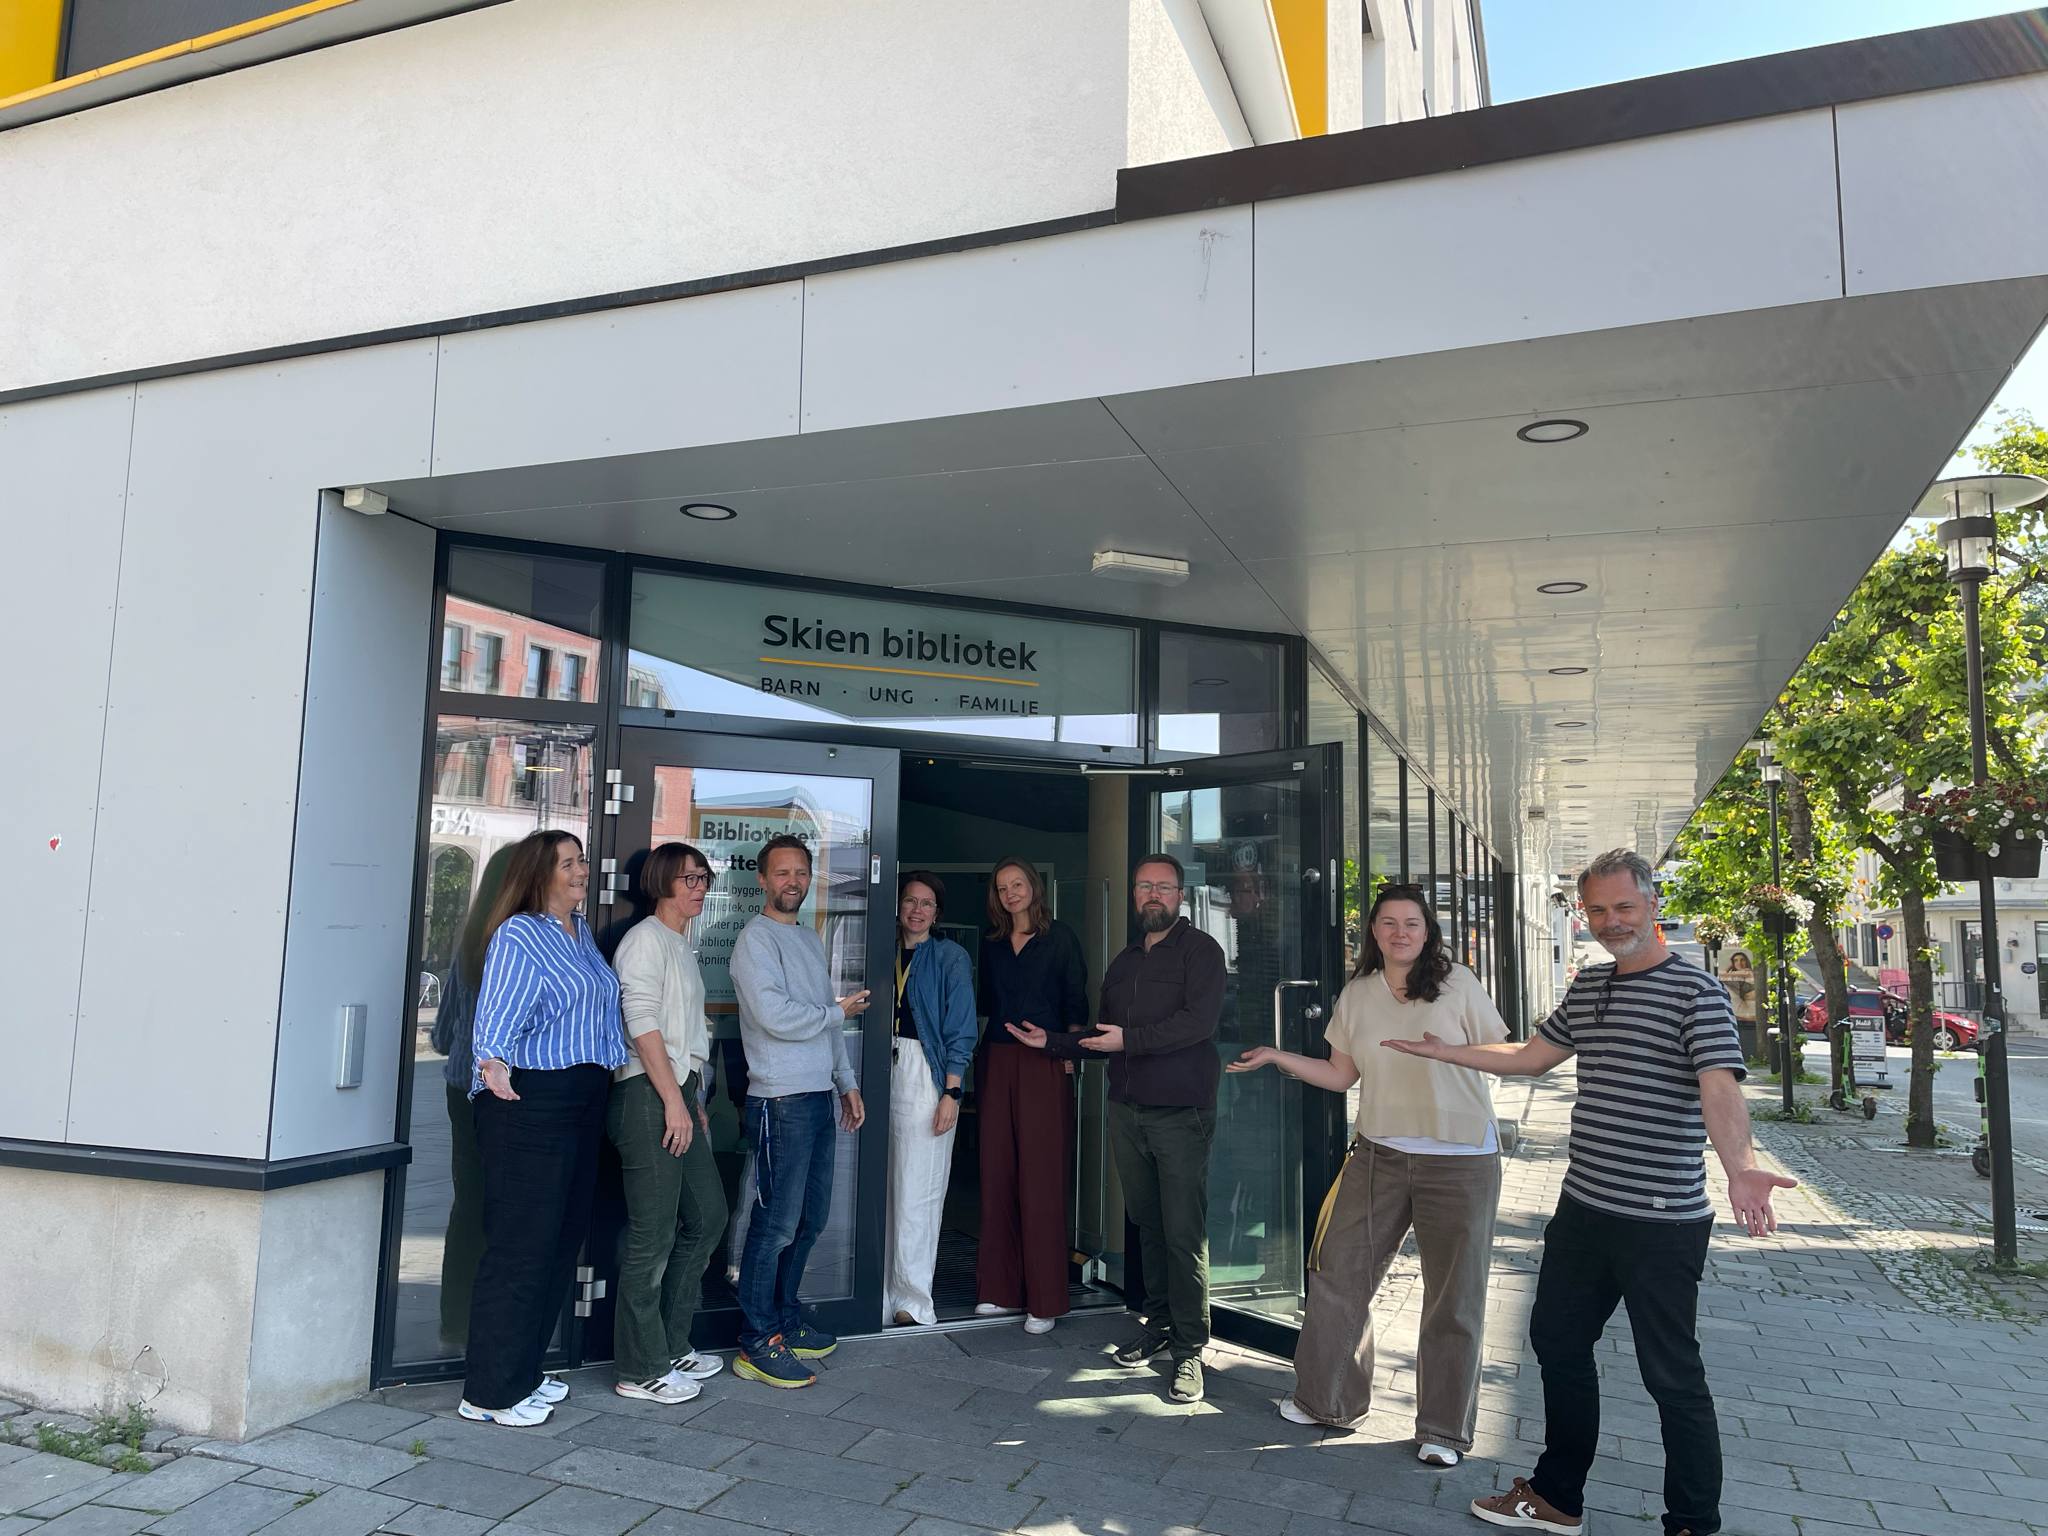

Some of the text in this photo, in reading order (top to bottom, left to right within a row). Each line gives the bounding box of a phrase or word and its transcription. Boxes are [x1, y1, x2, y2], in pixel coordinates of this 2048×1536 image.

[762, 614, 1037, 671] Skien bibliotek
[761, 677, 1039, 714] BARN UNG FAMILIE
[731, 885, 763, 897] bygger
[733, 919, 745, 932] på
